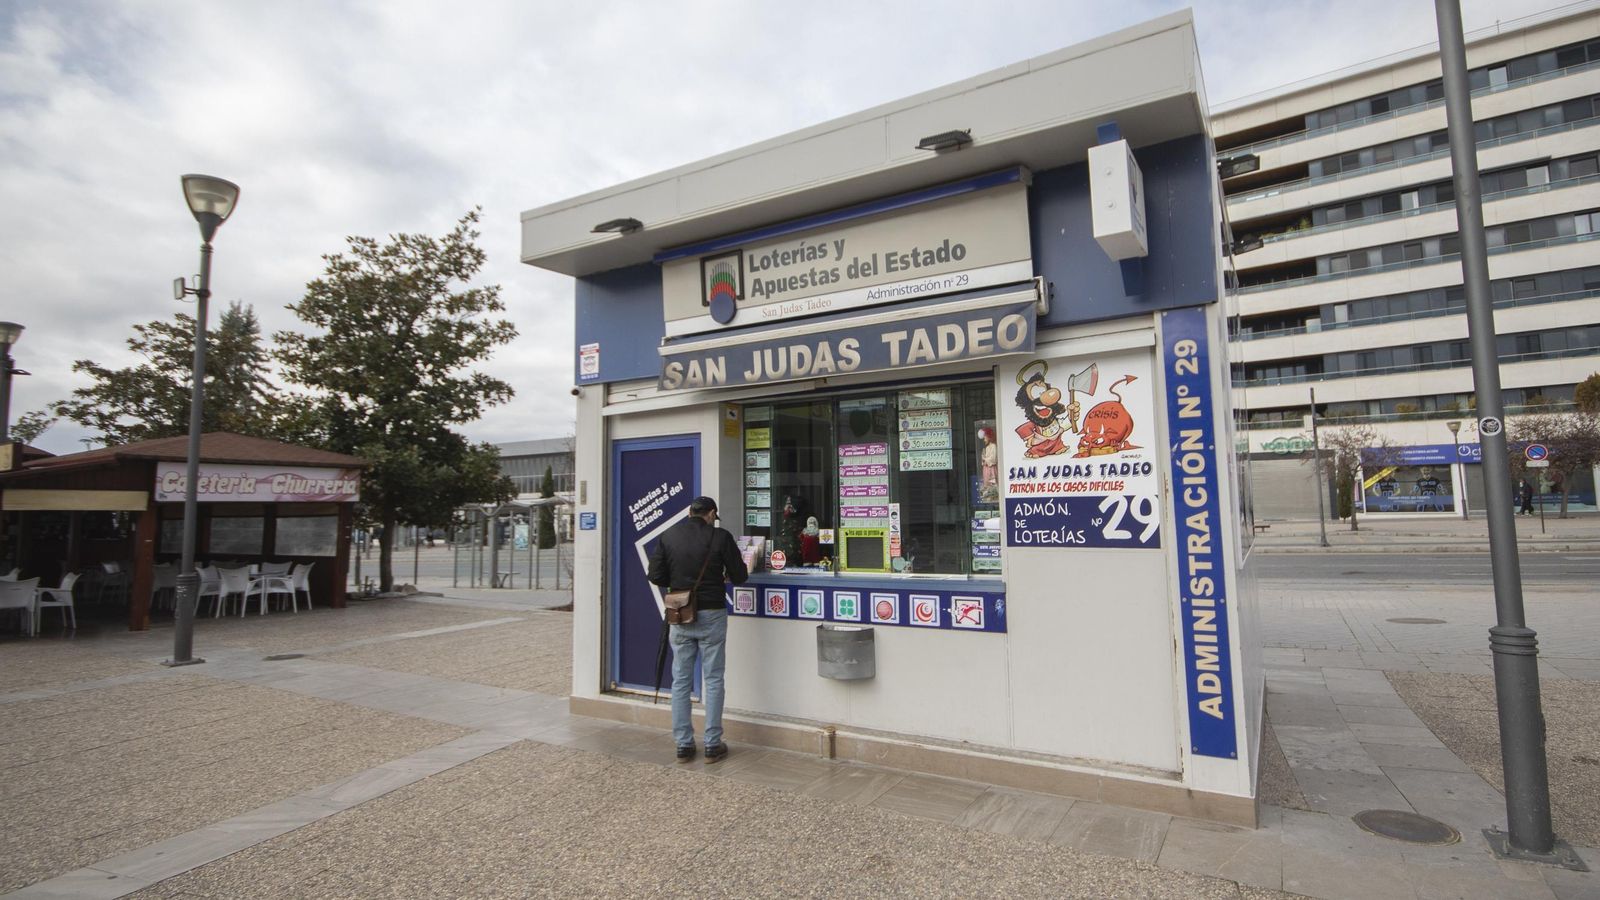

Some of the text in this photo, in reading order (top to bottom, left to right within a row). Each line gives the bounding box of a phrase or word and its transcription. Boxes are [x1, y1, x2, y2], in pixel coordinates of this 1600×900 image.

[749, 239, 845, 273] Loterías y
[751, 239, 967, 299] Apuestas del Estado
[866, 276, 941, 301] Administración
[955, 274, 969, 287] 29
[762, 298, 832, 318] San Judas Tadeo
[662, 313, 1028, 390] SAN JUDAS TADEO
[1174, 339, 1199, 376] 29
[1009, 461, 1152, 480] SAN JUDAS TADEO
[660, 482, 668, 493] y
[1009, 480, 1036, 494] PATRÓN
[1037, 481, 1046, 492] DE
[1047, 481, 1062, 492] LOS
[1063, 480, 1088, 492] CASOS
[632, 481, 683, 523] Apuestas del
[1013, 498, 1072, 516] ADMÓN.
[634, 508, 664, 532] Estado
[1014, 519, 1028, 529] DE
[1098, 493, 1161, 544] 29
[1014, 525, 1086, 544] LOTERÍAS
[1176, 429, 1224, 720] ADMINISTRACIÓN
